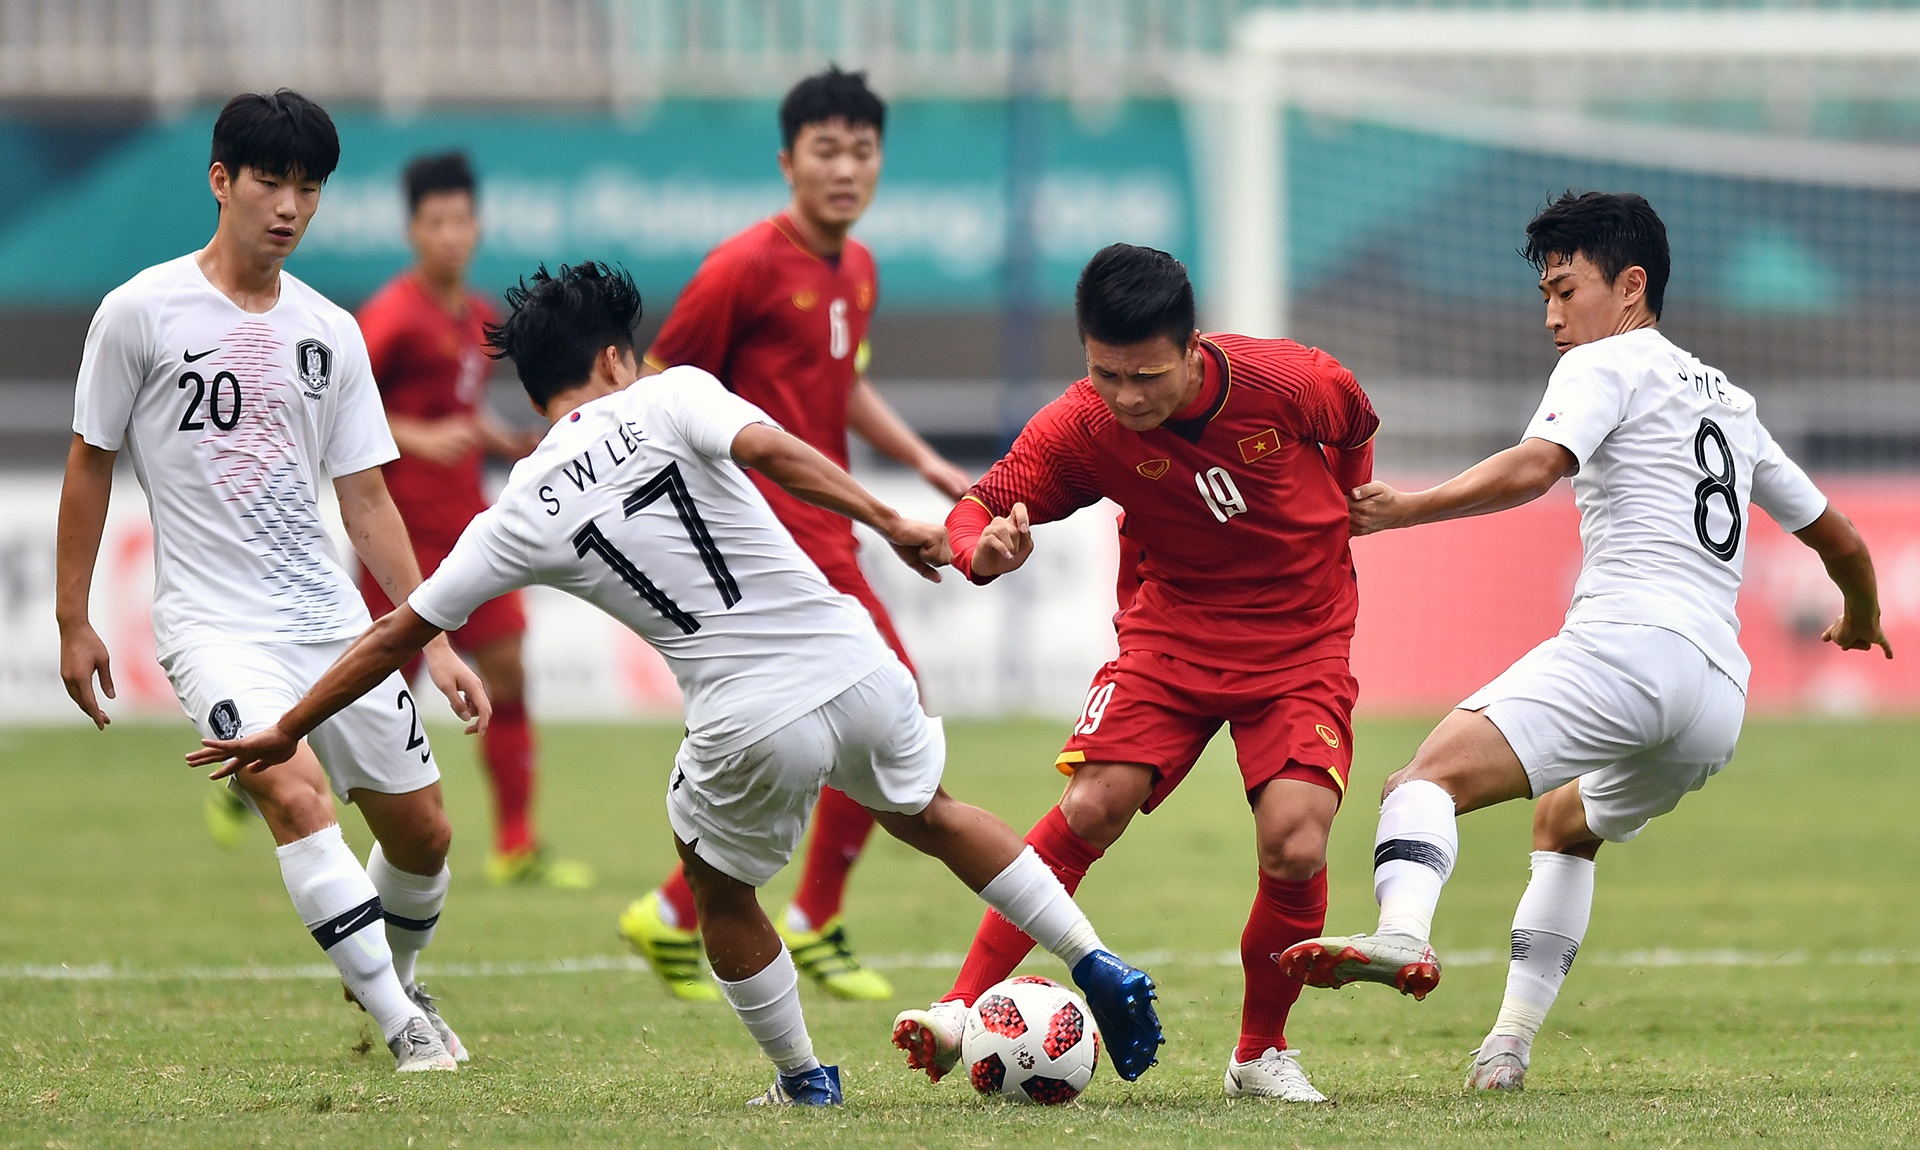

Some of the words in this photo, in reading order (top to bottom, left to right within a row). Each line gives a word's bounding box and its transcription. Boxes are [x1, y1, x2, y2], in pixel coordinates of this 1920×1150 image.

[829, 297, 850, 360] 6
[178, 371, 242, 432] 20
[538, 485, 561, 517] S
[562, 451, 598, 492] W
[604, 421, 650, 467] LEE
[1194, 466, 1248, 524] 19
[1694, 417, 1742, 562] 8
[572, 460, 743, 635] 17
[1074, 682, 1117, 737] 19
